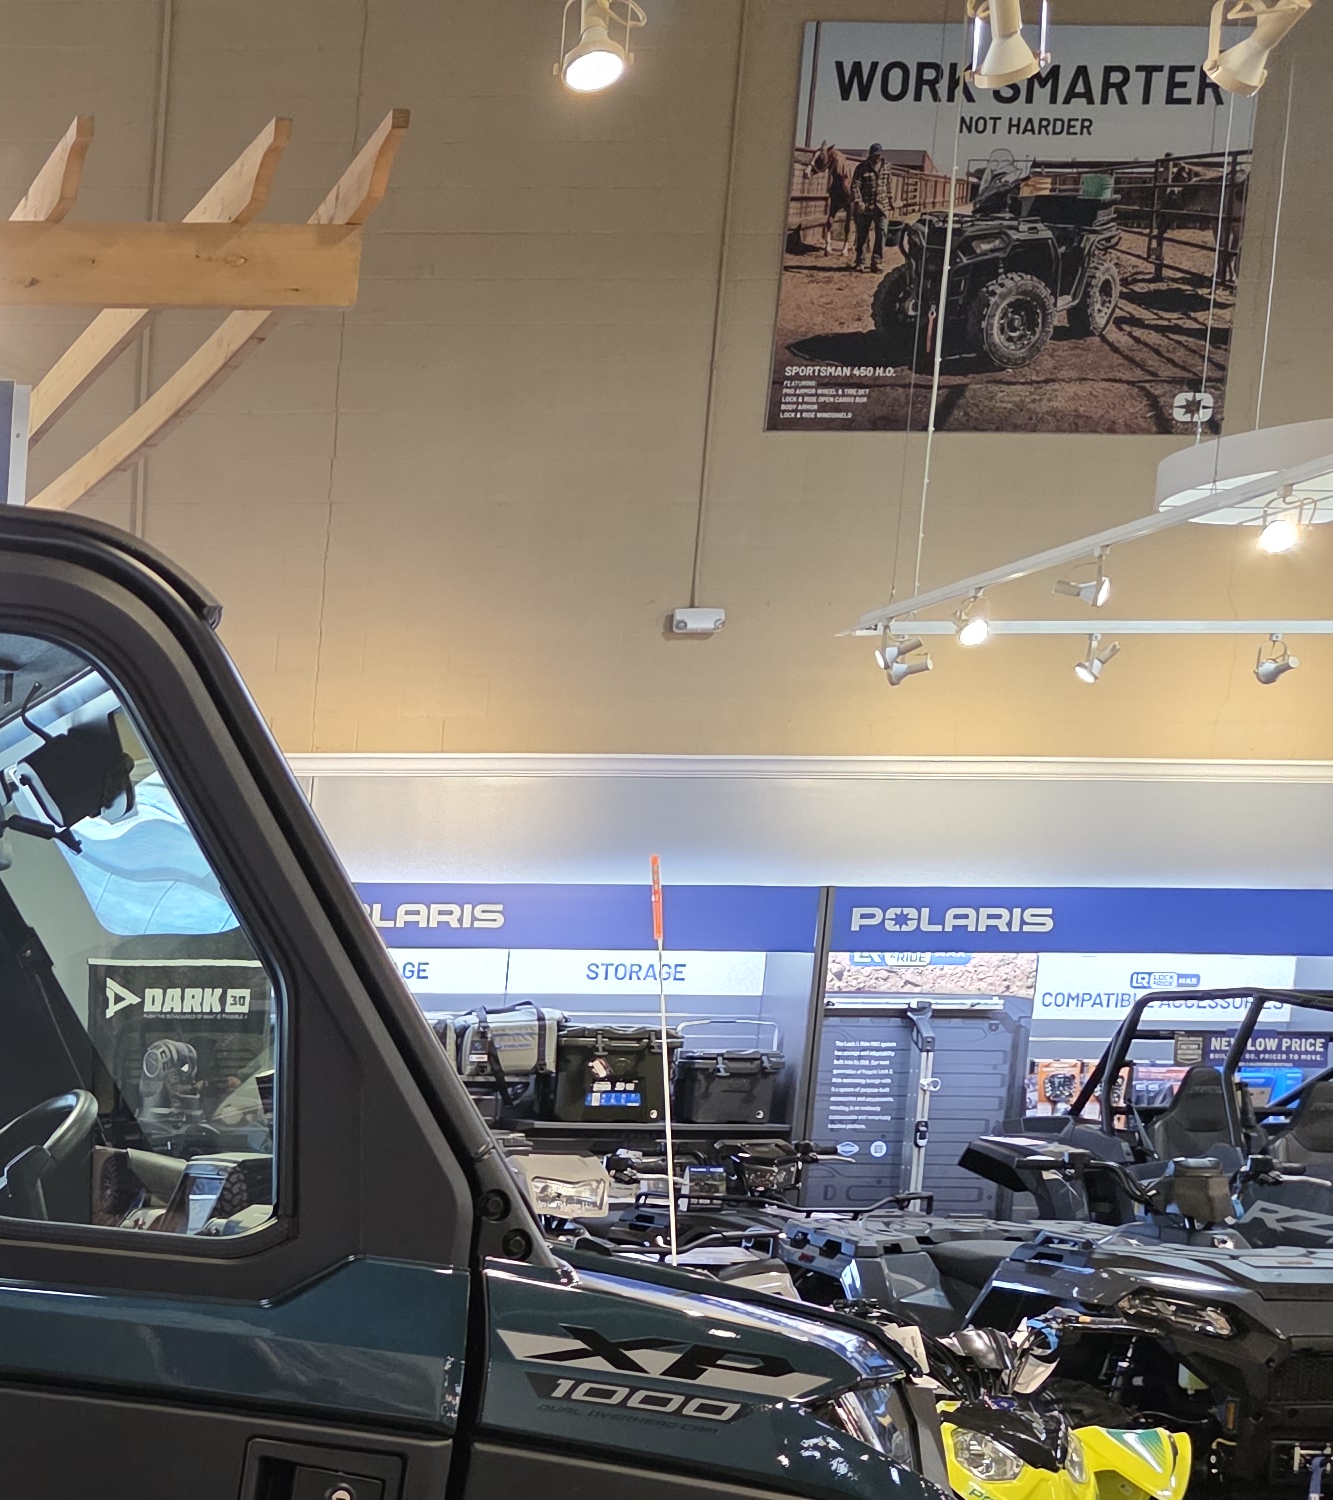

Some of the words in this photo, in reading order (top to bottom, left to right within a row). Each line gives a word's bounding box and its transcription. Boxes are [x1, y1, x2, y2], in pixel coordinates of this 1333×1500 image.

[835, 61, 975, 103] WORK
[959, 115, 1002, 135] NOT
[1008, 117, 1093, 136] HARDER
[785, 366, 851, 376] SPORTSMAN
[853, 367, 874, 376] 450
[876, 367, 896, 376] H.O.
[363, 903, 504, 928] LARIS
[850, 907, 1054, 932] POLARIS
[586, 963, 686, 981] STORAGE
[144, 988, 222, 1012] DARK
[1211, 1038, 1234, 1050] NE
[1247, 1039, 1277, 1051] LOW
[1282, 1039, 1325, 1052] PRICE
[523, 1323, 797, 1380] XP
[550, 1378, 741, 1421] 1000
[537, 1404, 583, 1418] DUAL
[680, 1423, 719, 1435] CAM
